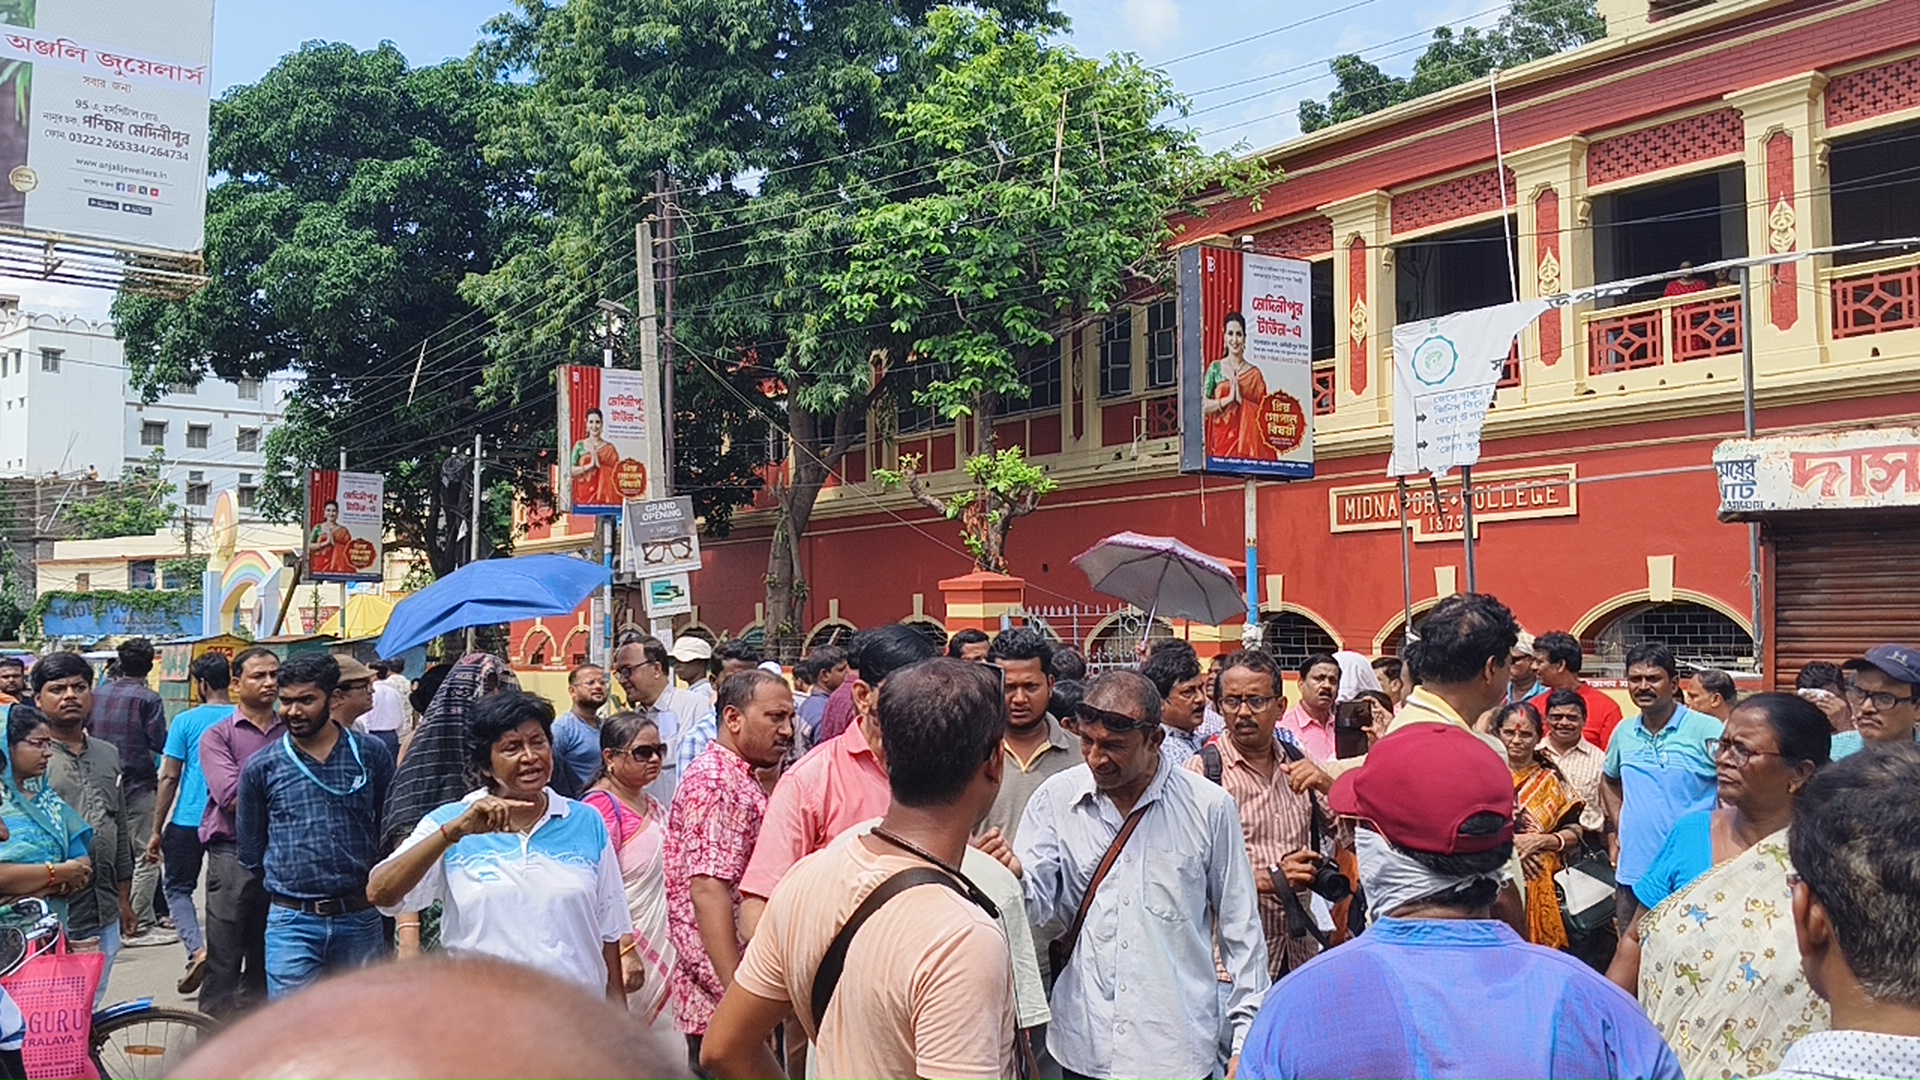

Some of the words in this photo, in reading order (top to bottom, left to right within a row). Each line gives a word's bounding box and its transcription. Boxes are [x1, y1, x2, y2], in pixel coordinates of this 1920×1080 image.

[5, 34, 89, 63] অঞ্জলি
[95, 51, 207, 85] জুয়েলার্স
[82, 75, 106, 88] সবার
[111, 82, 132, 93] জন্য
[75, 99, 89, 110] 95
[82, 114, 125, 133] পশ্চিম
[128, 123, 190, 148] মেদিনীপুর
[69, 132, 103, 147] 03222
[106, 139, 189, 161] 265334/264734
[75, 159, 167, 179] www.anjalijewellers.in
[1252, 294, 1304, 321] মেদিনীপুর
[1256, 316, 1302, 338] টাউন-এ
[1265, 412, 1298, 425] গোপাল
[1461, 479, 1559, 508] OLLEGE
[642, 508, 682, 521] OPENING
[645, 501, 676, 512] GRAND
[1428, 514, 1464, 532] 1873
[29, 1009, 84, 1034] GURU
